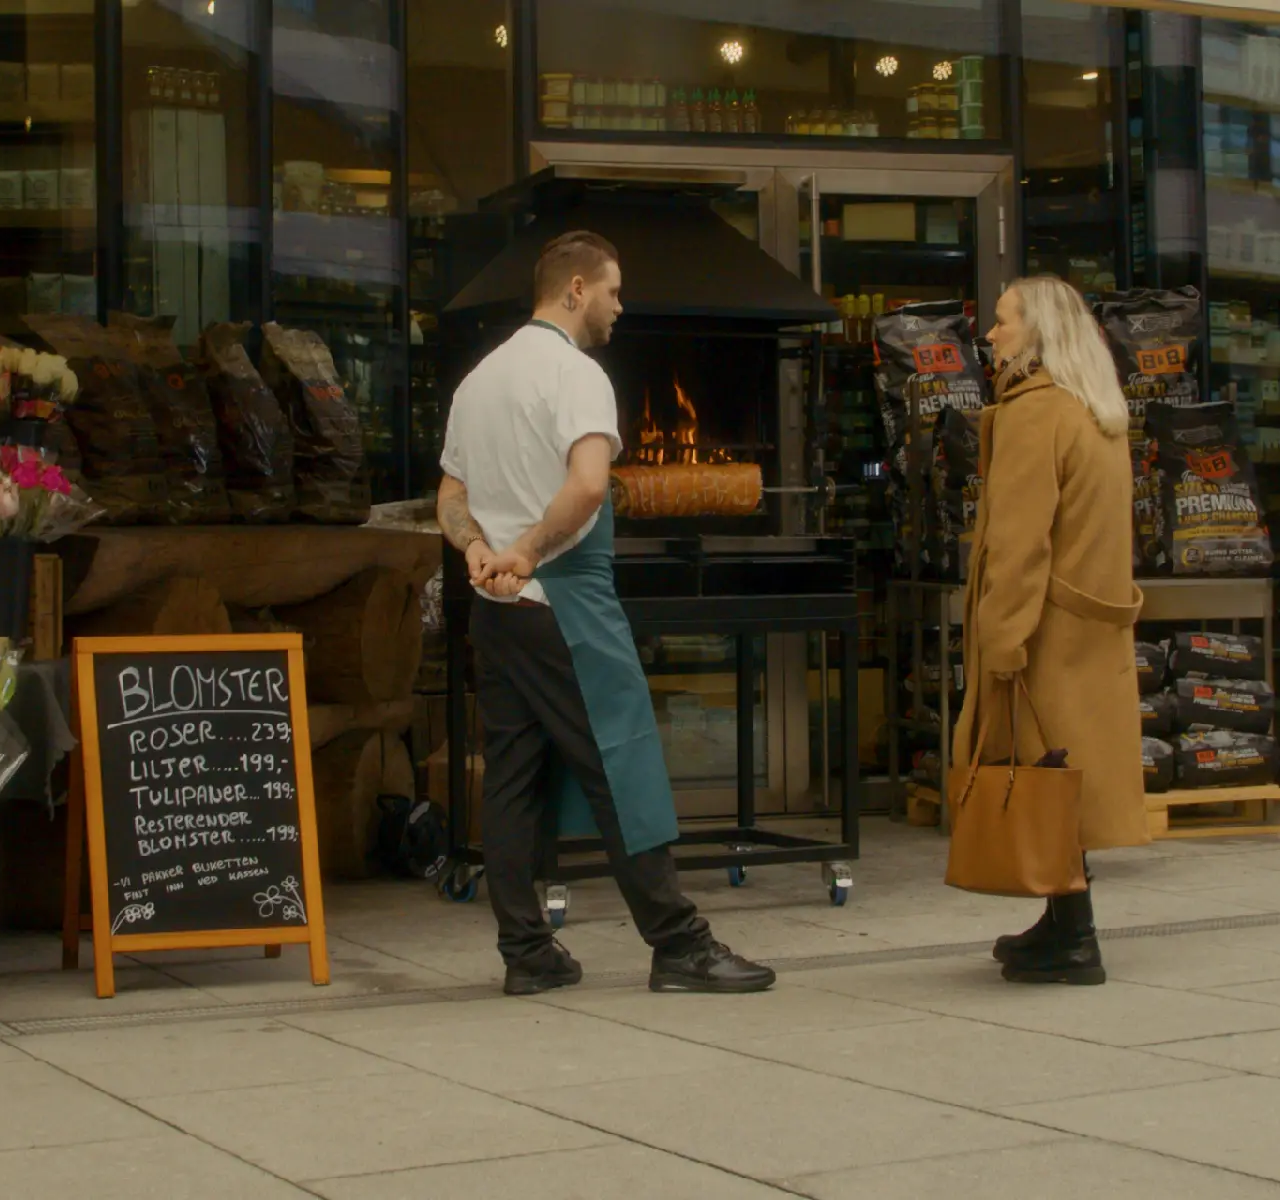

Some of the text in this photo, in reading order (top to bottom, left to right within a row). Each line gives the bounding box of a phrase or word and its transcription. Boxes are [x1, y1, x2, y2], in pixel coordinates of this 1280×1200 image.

[1176, 494, 1257, 516] PREMIUM
[119, 665, 288, 719] BLOMSTER
[134, 811, 252, 836] RESTERENDER
[124, 867, 269, 901] FINT INN VED KASSEN
[141, 864, 184, 885] PAKKER
[191, 856, 259, 874] BUKETTEN
